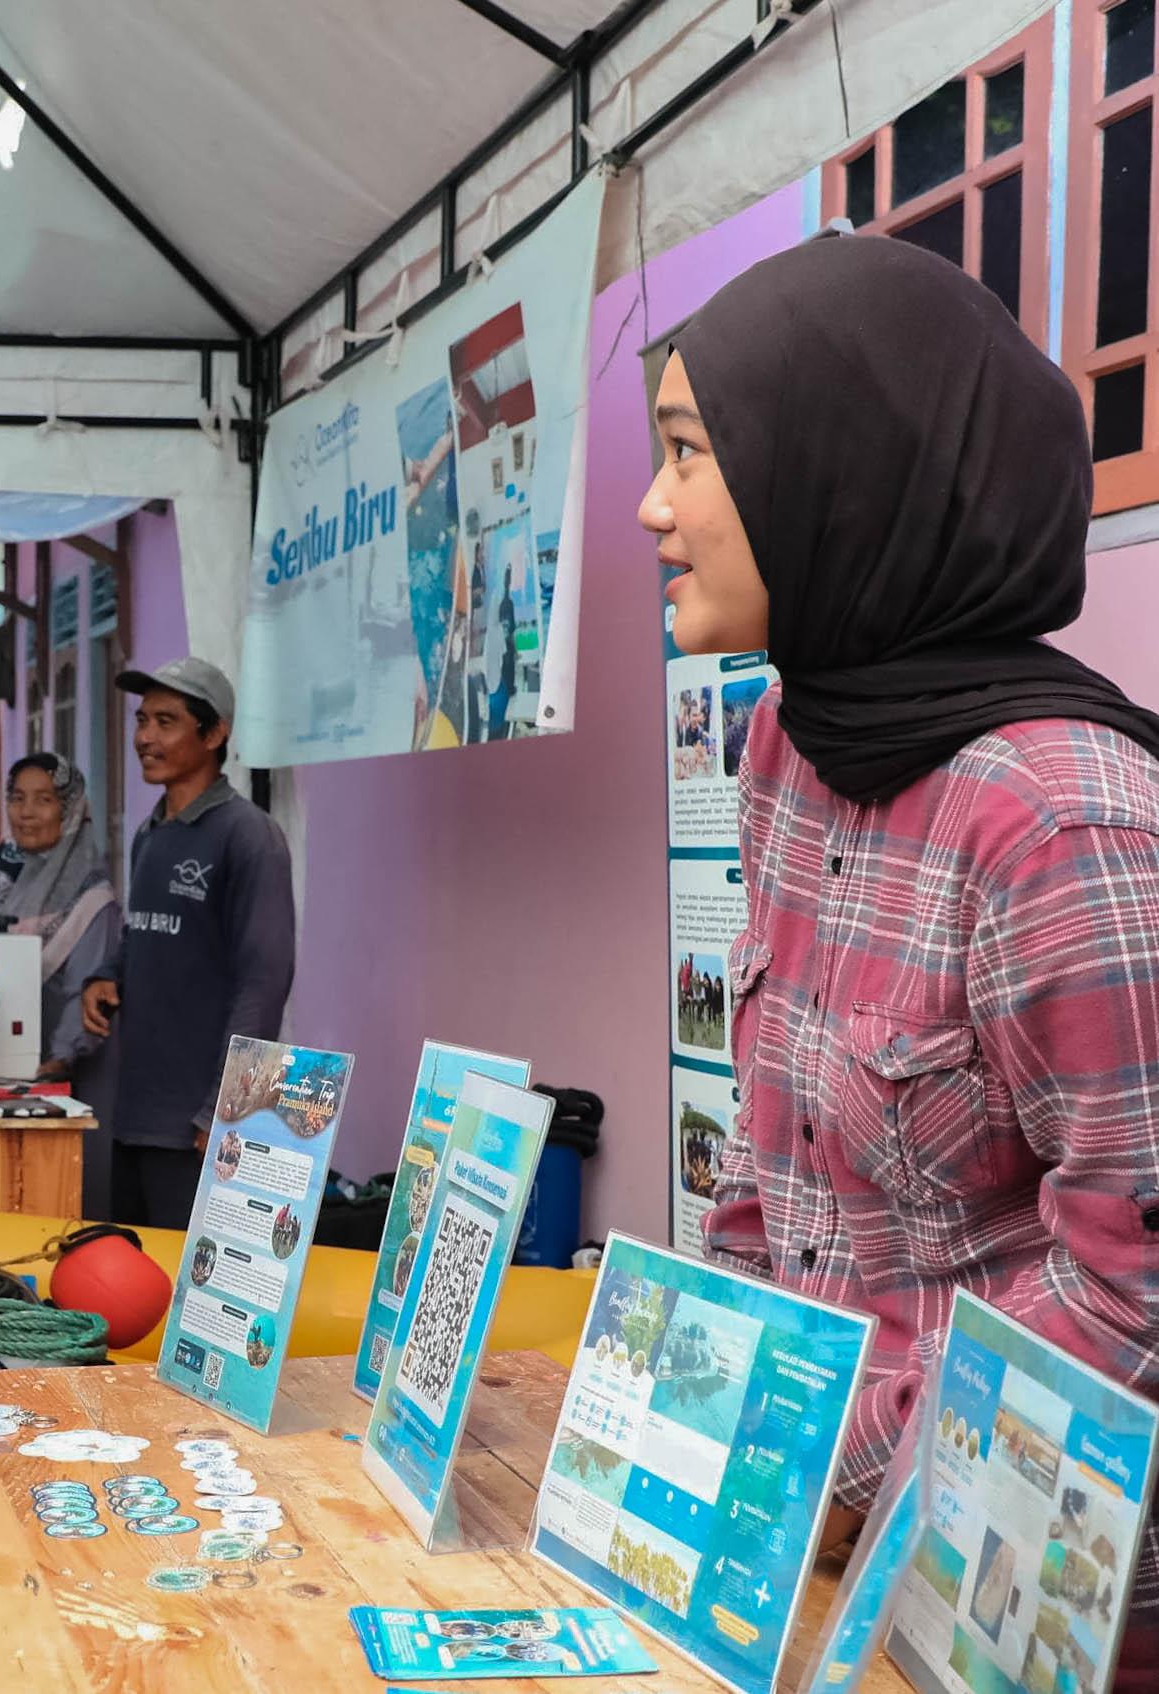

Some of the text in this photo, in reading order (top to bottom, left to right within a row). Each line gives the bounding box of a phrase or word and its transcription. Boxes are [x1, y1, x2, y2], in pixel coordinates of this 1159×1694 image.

[266, 481, 397, 585] Seribu Biru
[761, 1392, 768, 1411] 1
[745, 1444, 755, 1464] 2
[730, 1499, 740, 1519] 3
[715, 1556, 725, 1575] 4
